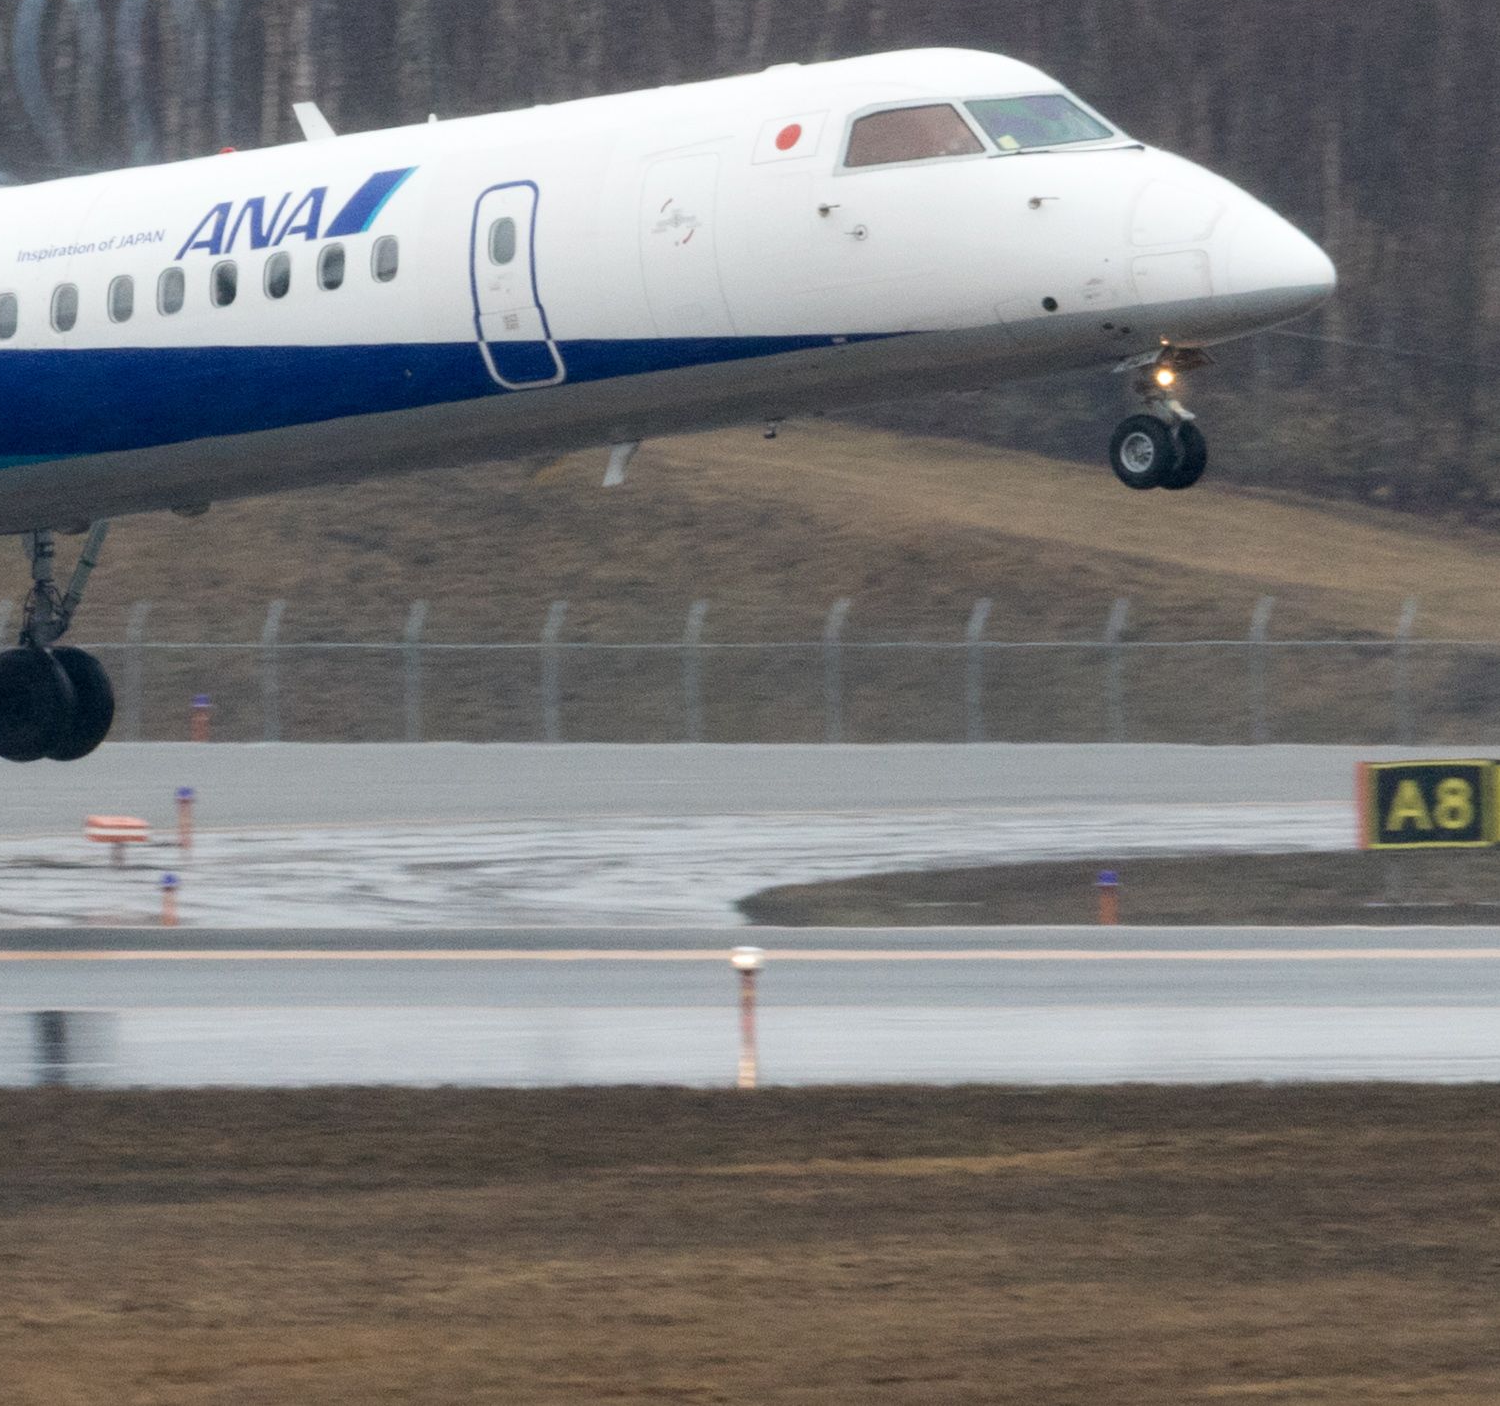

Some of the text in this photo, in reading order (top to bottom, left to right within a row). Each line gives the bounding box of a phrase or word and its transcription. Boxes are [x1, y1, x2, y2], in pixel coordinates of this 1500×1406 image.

[17, 229, 166, 262] Inspiration of JAPAN
[174, 186, 328, 261] ANA
[1385, 777, 1475, 831] A8
